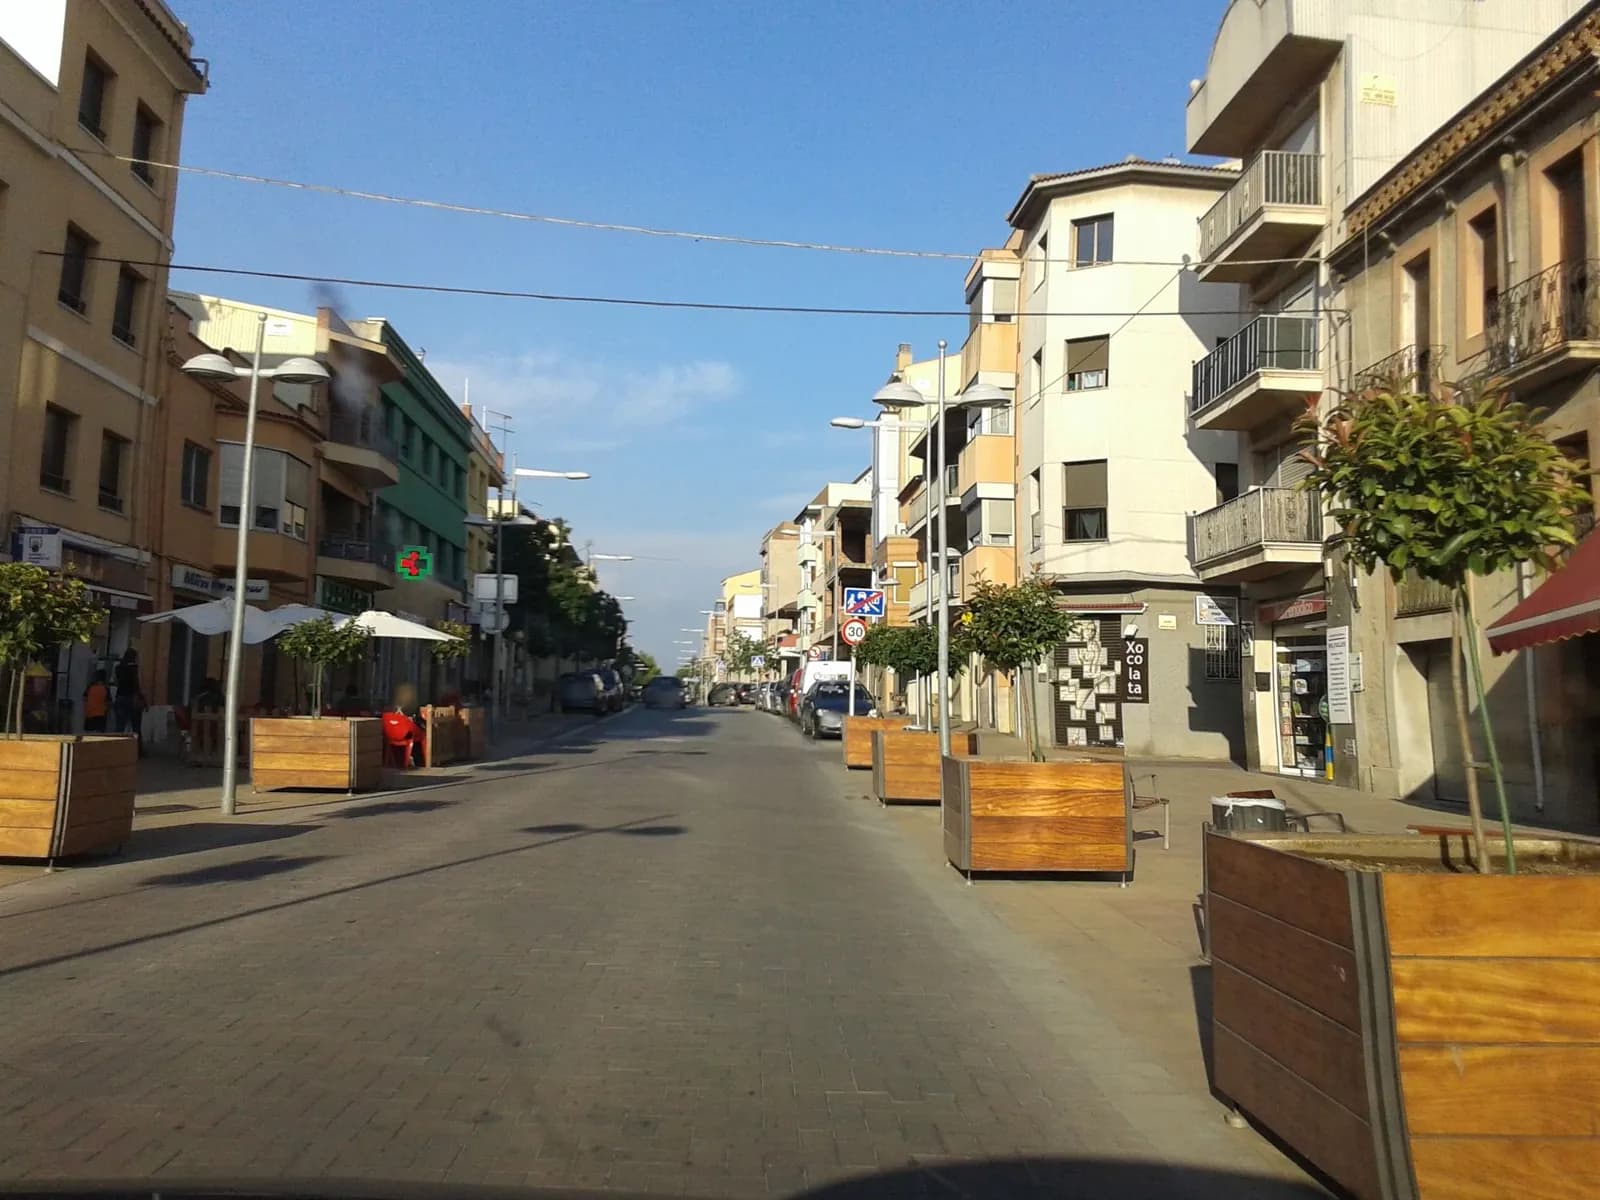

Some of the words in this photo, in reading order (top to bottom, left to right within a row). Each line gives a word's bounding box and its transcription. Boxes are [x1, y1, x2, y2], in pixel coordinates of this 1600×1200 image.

[848, 627, 863, 637] 30
[1126, 641, 1144, 654] Xo
[1126, 655, 1143, 665] co
[1129, 667, 1141, 680] la
[1128, 682, 1142, 694] ta
